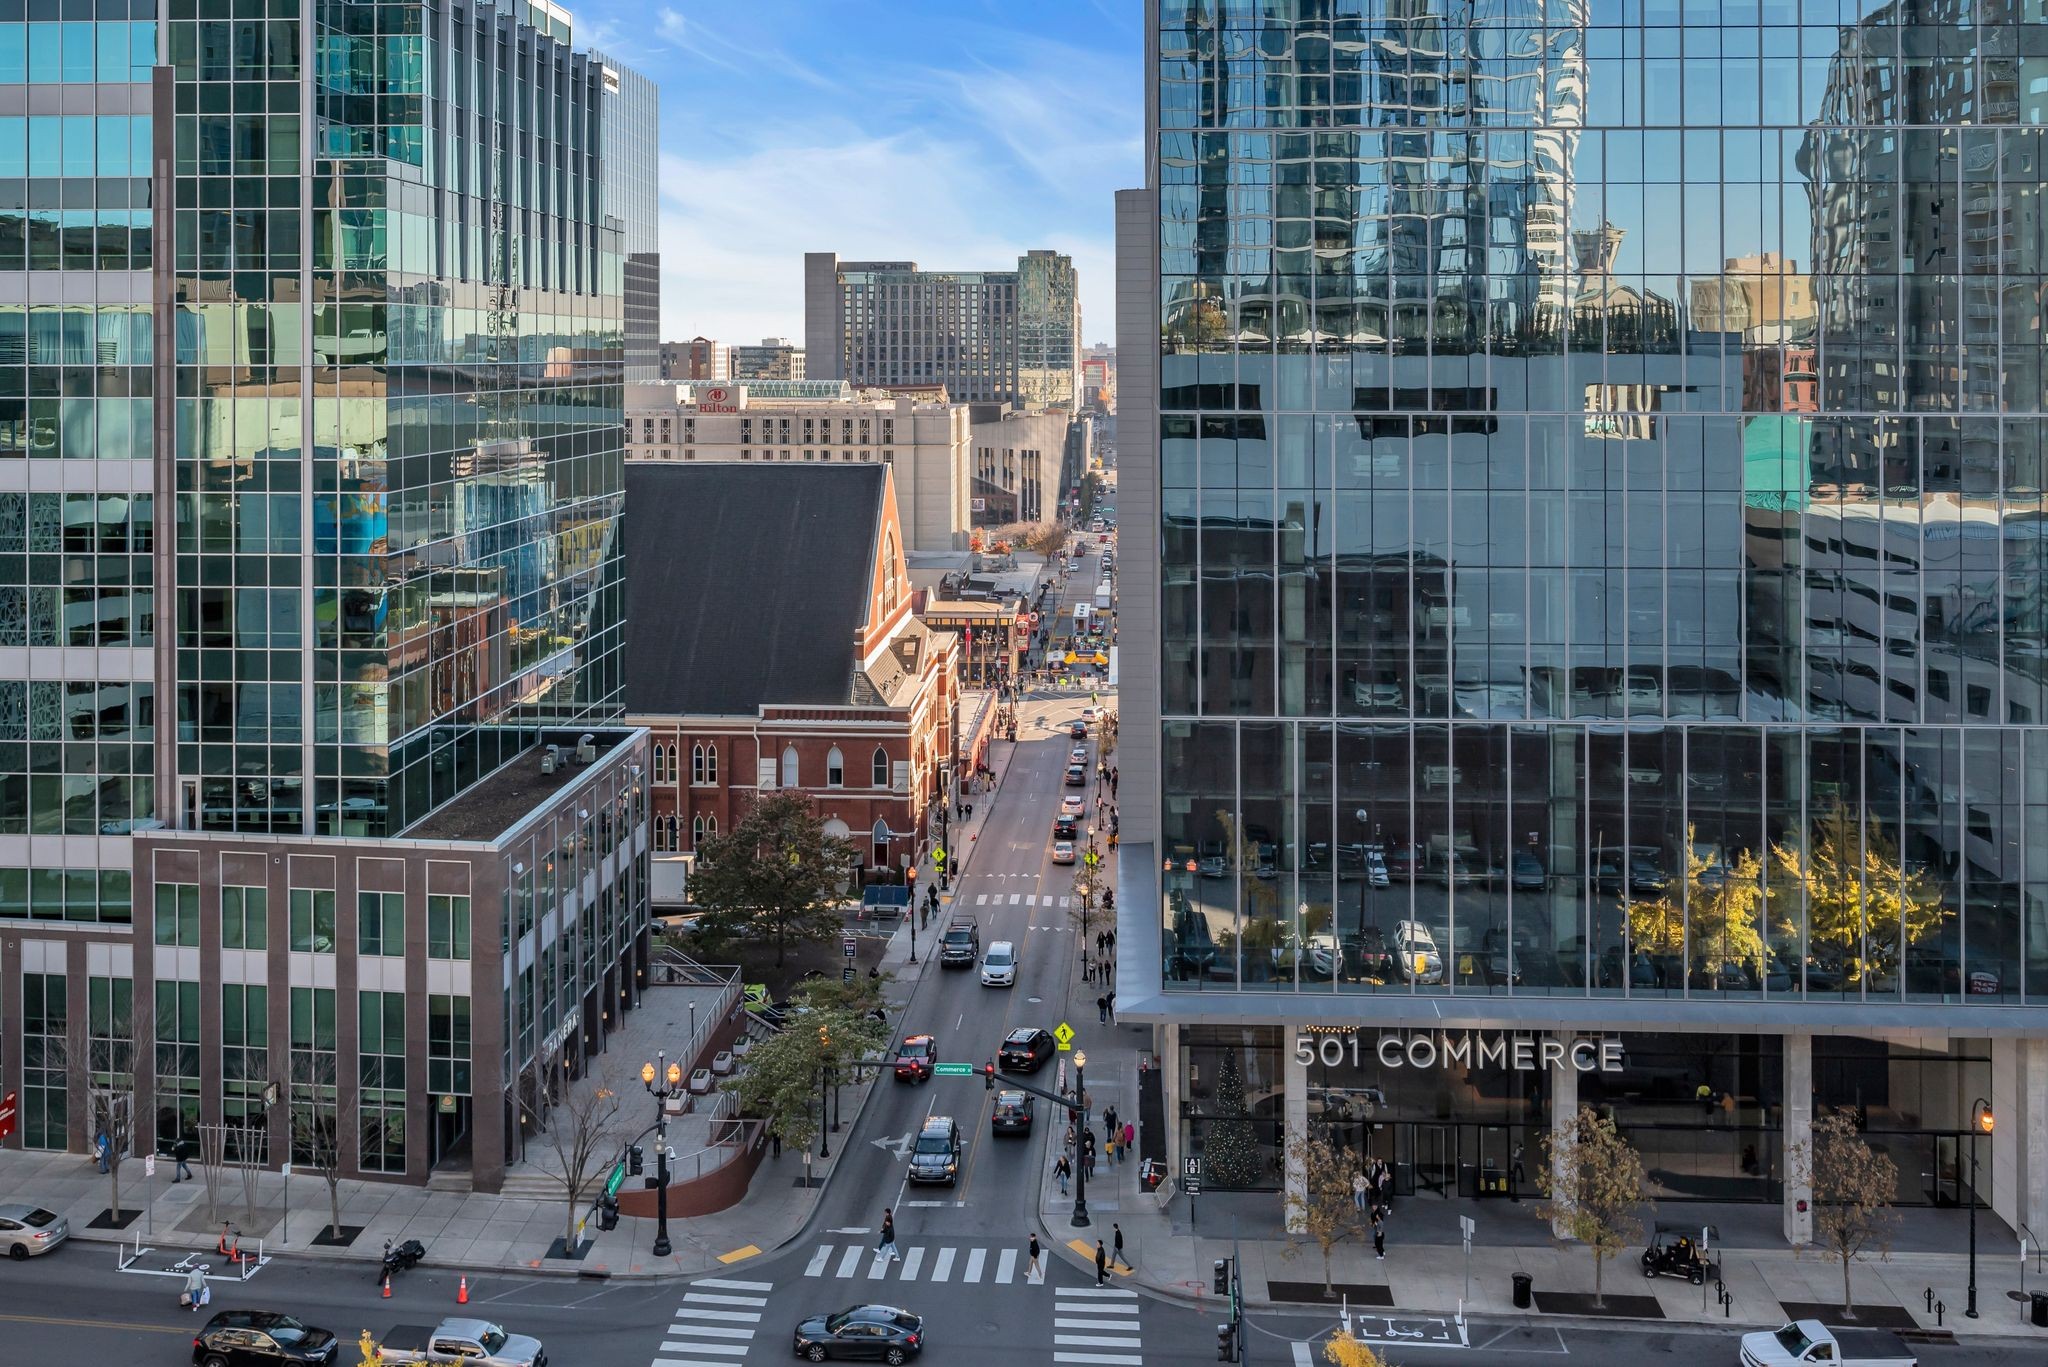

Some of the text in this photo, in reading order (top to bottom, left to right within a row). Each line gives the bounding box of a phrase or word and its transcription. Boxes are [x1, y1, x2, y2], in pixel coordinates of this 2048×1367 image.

[700, 403, 737, 413] Hilton
[548, 1013, 577, 1058] PANERA
[1296, 1037, 1624, 1072] 501 COMMERCE
